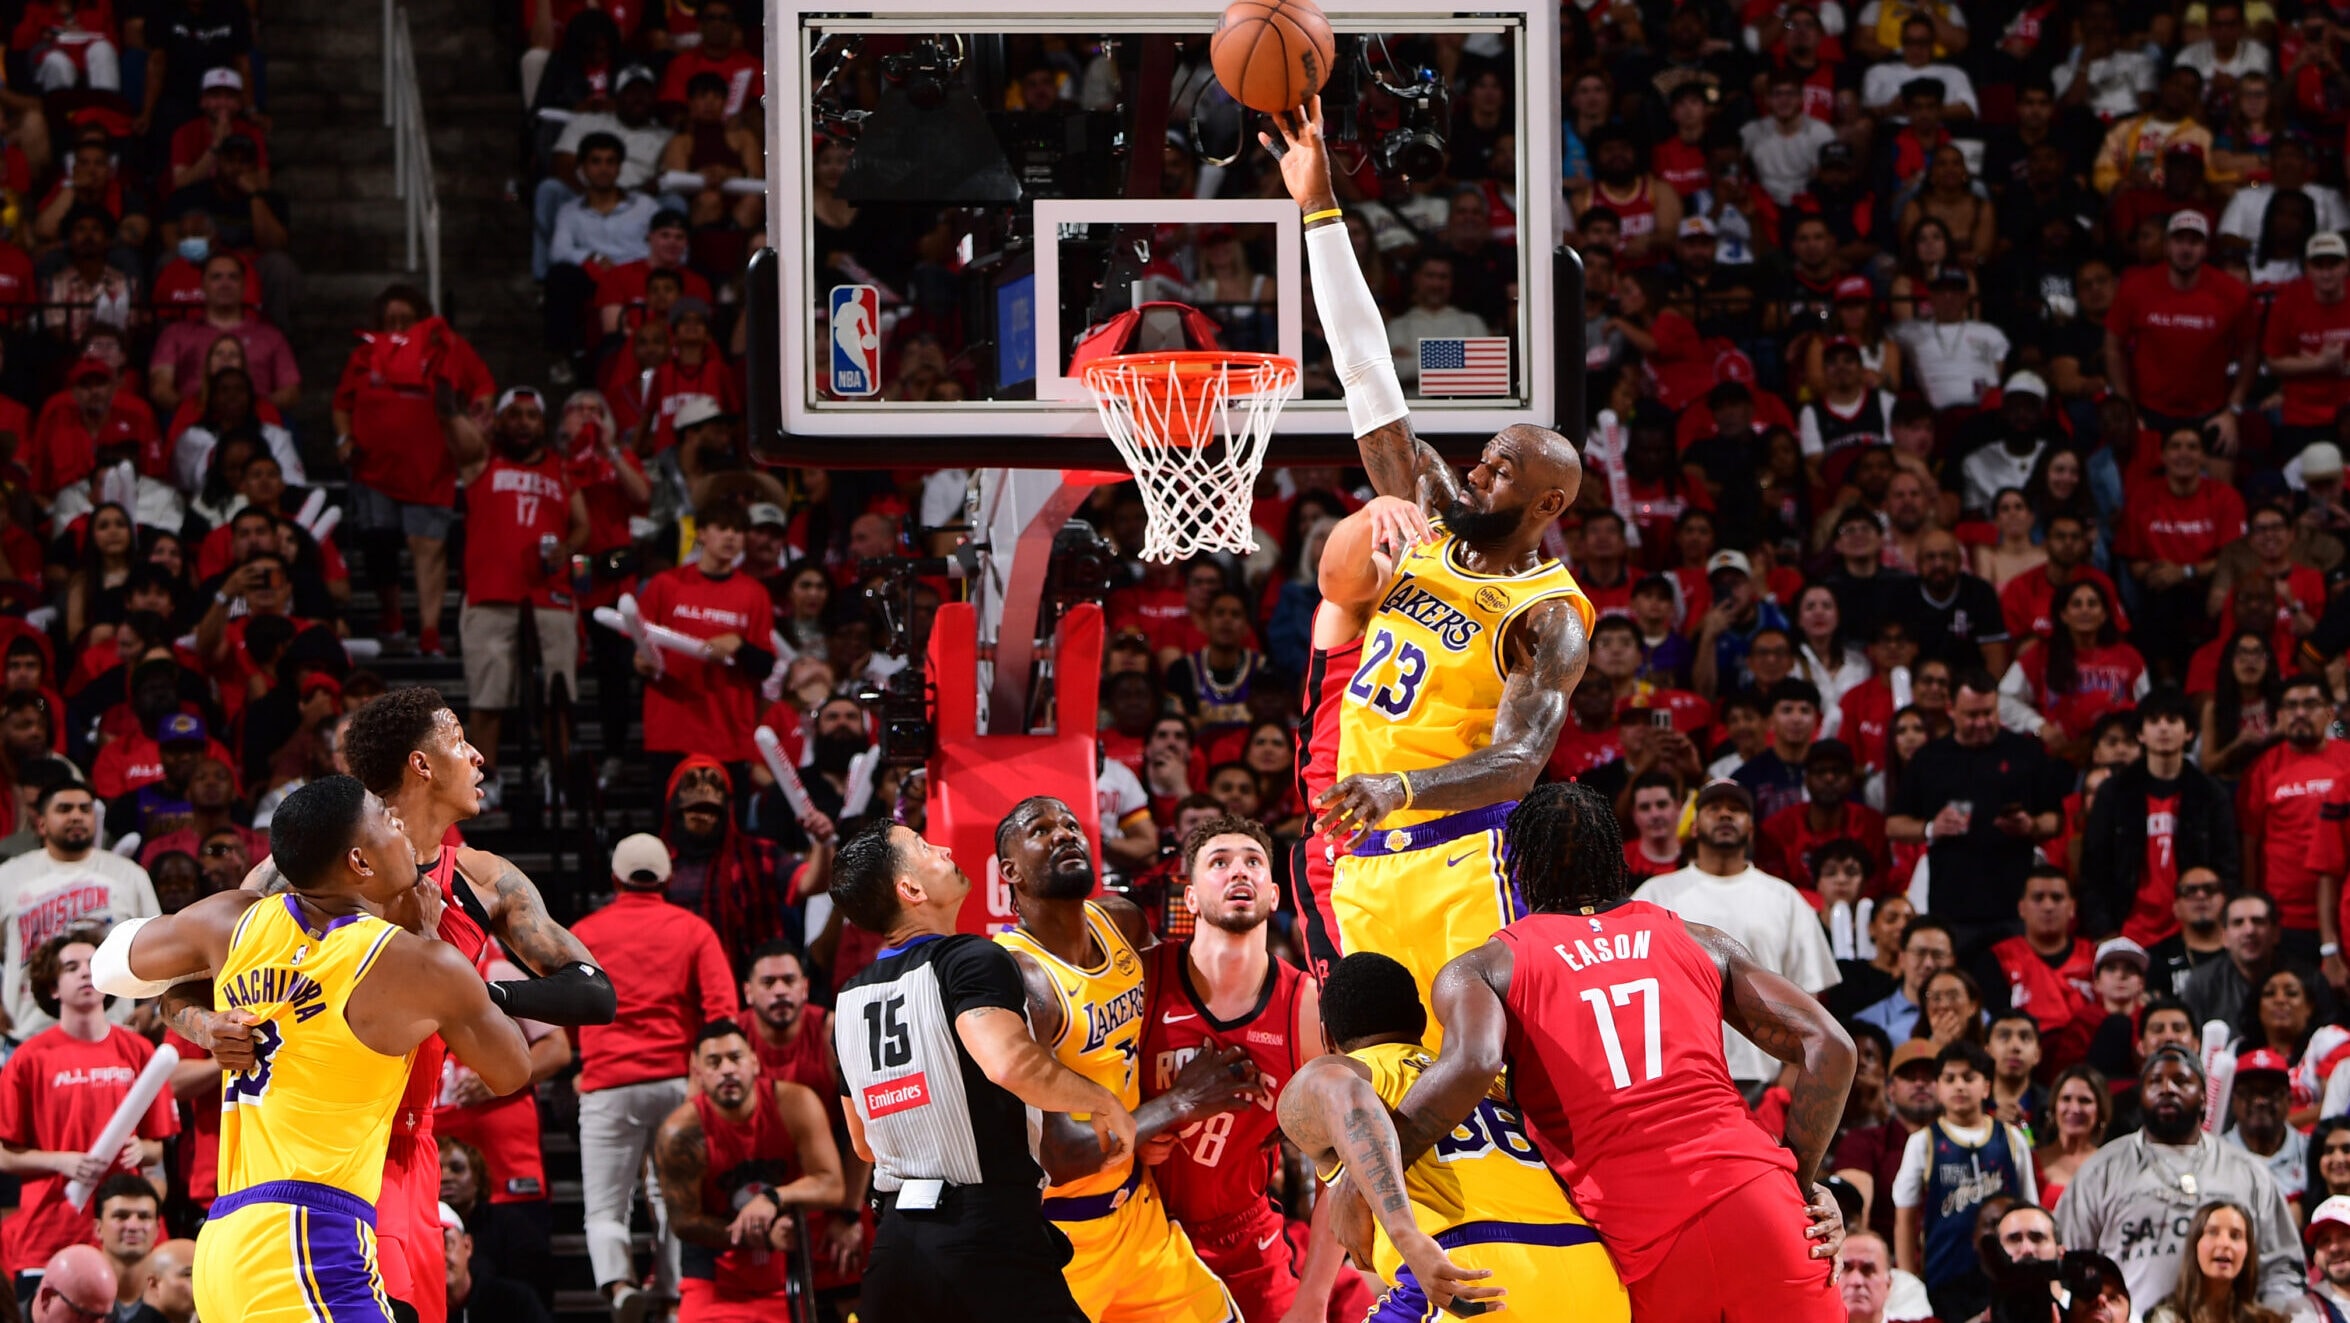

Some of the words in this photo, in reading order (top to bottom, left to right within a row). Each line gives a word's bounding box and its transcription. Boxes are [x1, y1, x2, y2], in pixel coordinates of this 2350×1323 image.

[838, 370, 862, 388] NBA
[492, 468, 565, 502] ROCKETS
[516, 493, 541, 527] 17
[672, 604, 702, 621] ALL
[1378, 571, 1482, 651] LAKERS
[1347, 628, 1428, 719] 23
[2274, 783, 2306, 800] ALL
[18, 886, 109, 963] HOUSTON
[1553, 930, 1651, 972] EASON
[863, 993, 912, 1072] 15
[1080, 981, 1145, 1055] LAKERS
[1579, 977, 1663, 1090] 17
[53, 1068, 89, 1088] ALL
[868, 1084, 922, 1110] Emirates
